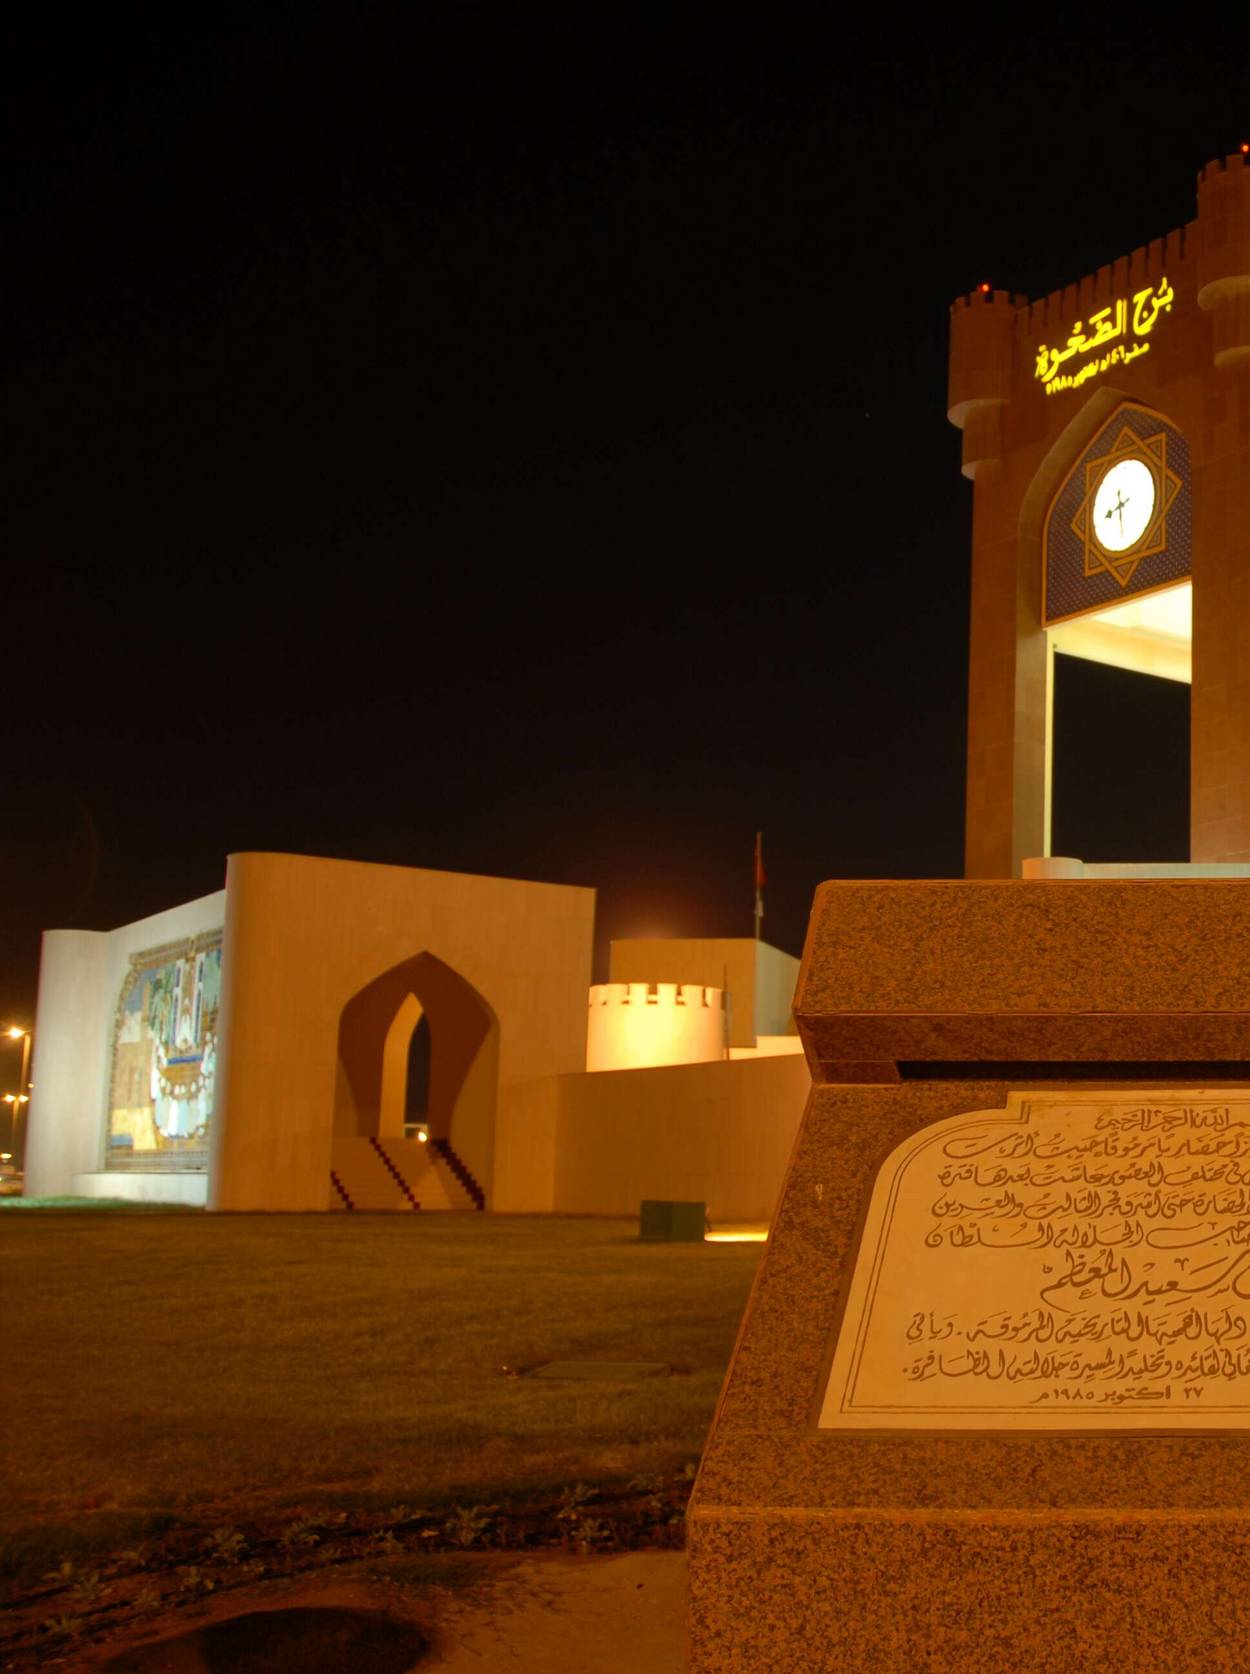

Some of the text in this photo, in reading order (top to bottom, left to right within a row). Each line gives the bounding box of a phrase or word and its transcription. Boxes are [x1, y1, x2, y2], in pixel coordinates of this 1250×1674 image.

[1133, 276, 1174, 336] برج
[1095, 1109, 1150, 1131] الرحيم
[1148, 1109, 1193, 1132] الرحمن
[1193, 1107, 1229, 1129] الله
[1184, 1386, 1204, 1399] ٢٧
